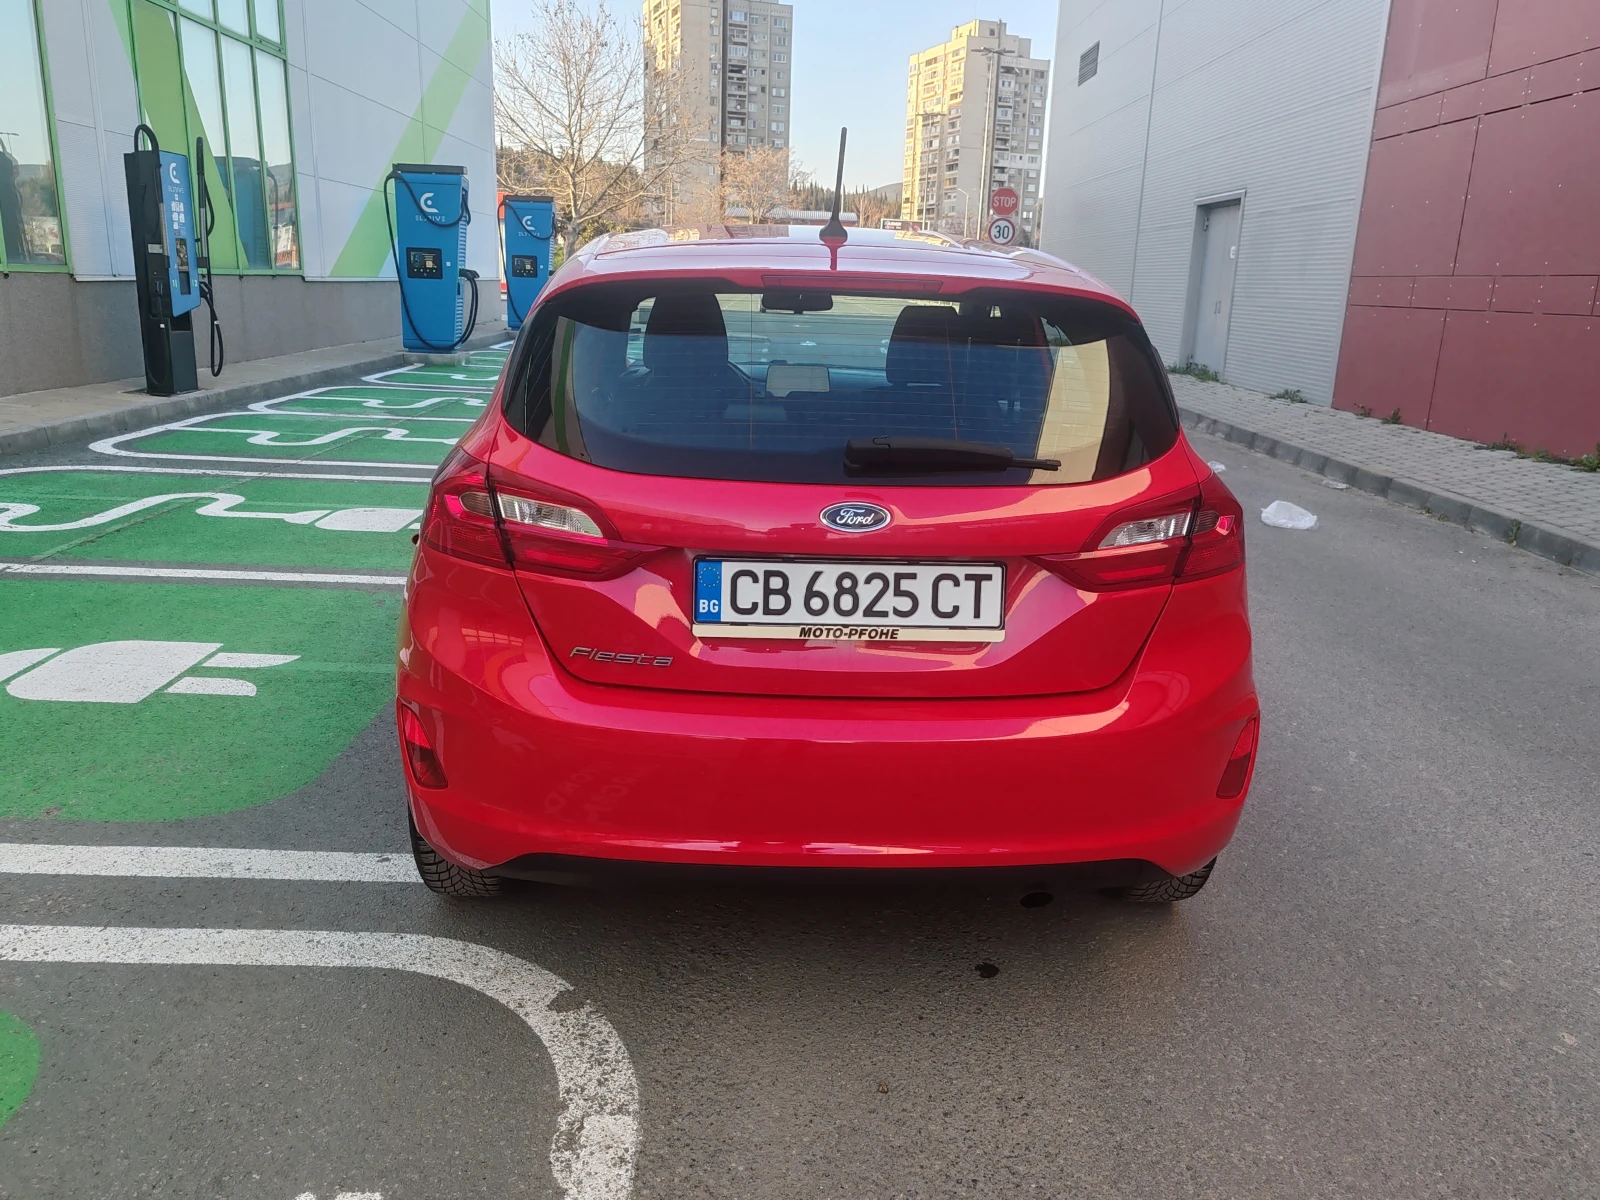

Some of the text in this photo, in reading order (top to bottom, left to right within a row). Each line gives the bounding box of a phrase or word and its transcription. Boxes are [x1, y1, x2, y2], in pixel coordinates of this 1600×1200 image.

[993, 196, 1016, 207] STOP
[994, 225, 1010, 239] 30
[836, 508, 875, 525] Ford
[729, 568, 993, 620] CB 6825 CT
[699, 599, 719, 614] BG
[798, 626, 900, 640] MOTO-PFOHE
[568, 646, 674, 668] Fiesta
